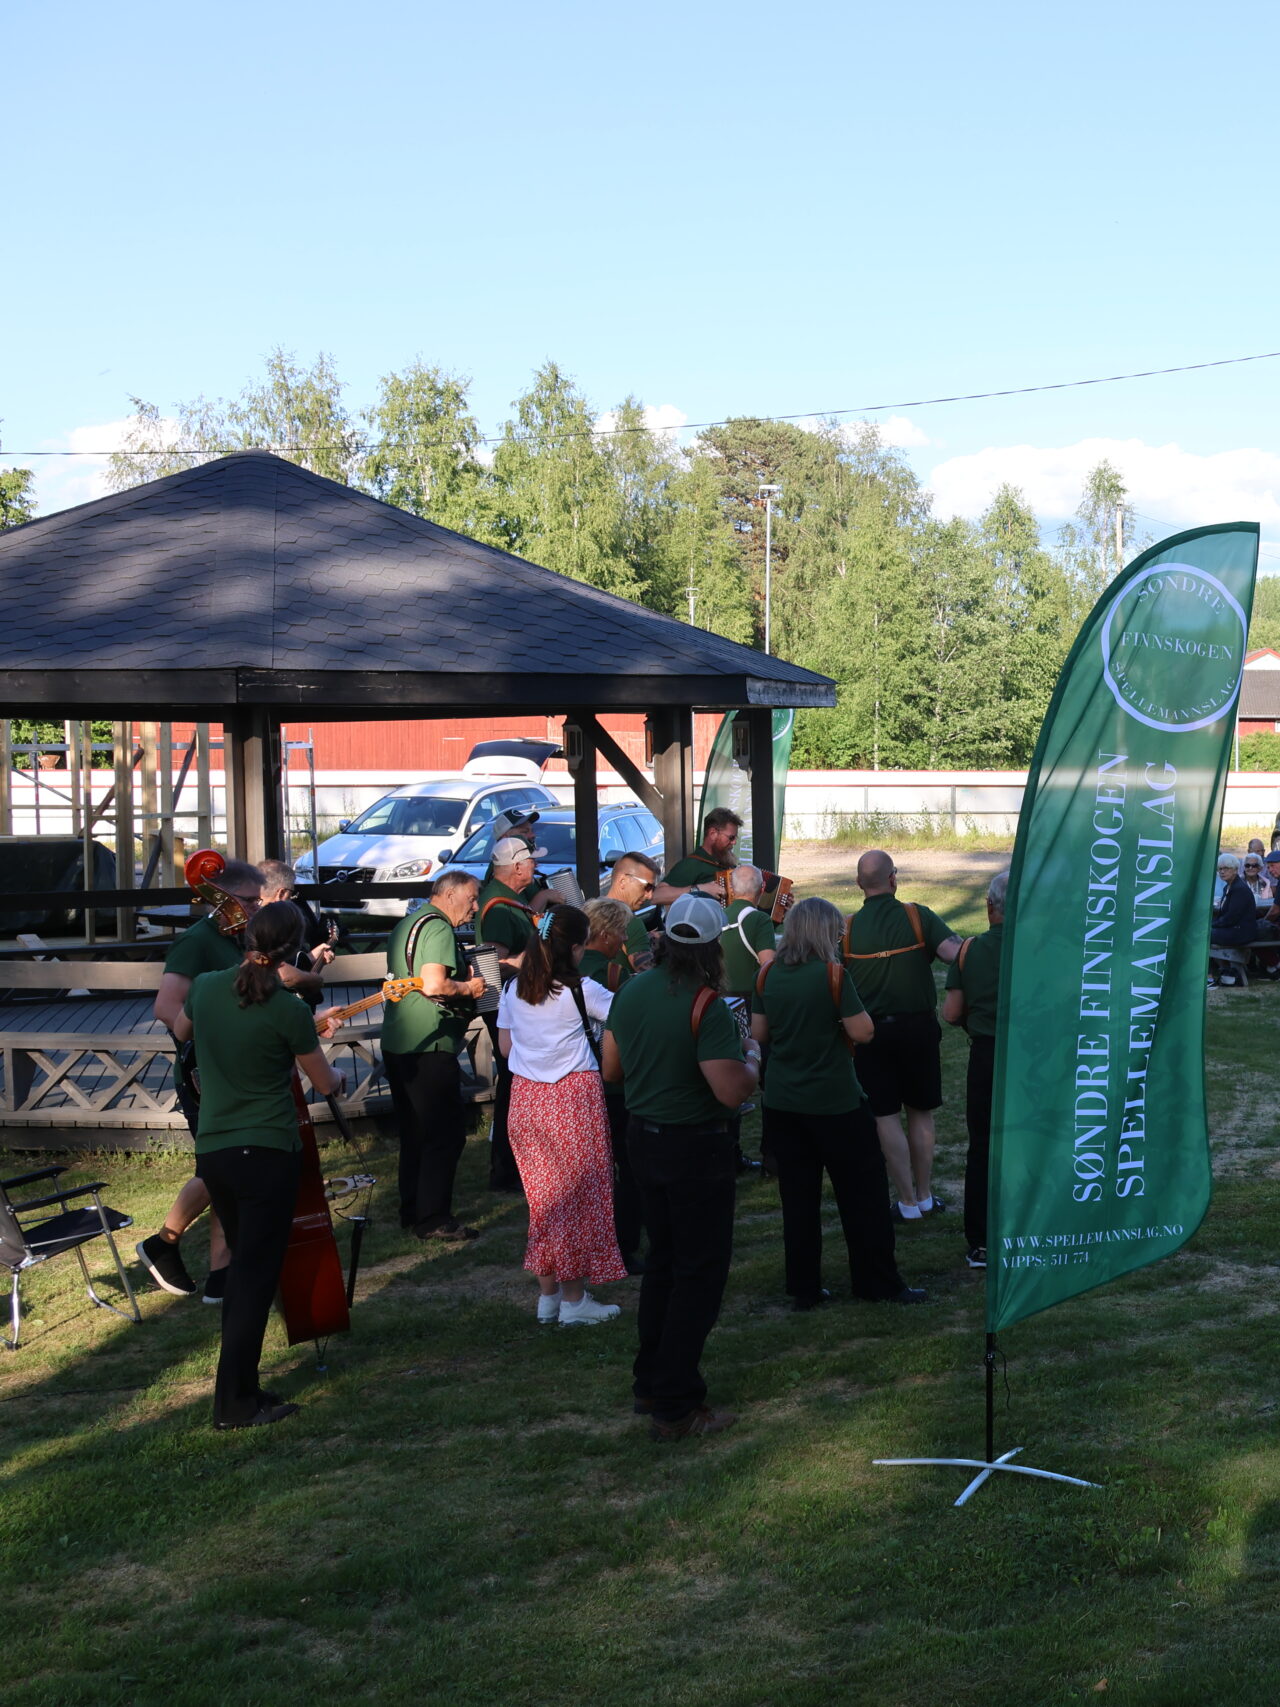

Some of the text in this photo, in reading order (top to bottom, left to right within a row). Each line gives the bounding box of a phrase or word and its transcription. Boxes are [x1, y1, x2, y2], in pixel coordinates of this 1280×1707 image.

[1121, 631, 1234, 660] FINNSKOGEN
[1111, 660, 1236, 720] SPELLEMANNSLAG
[1072, 748, 1129, 1202] SØNDRE FINNSKOGEN
[1115, 759, 1178, 1198] SPELLEMANNSLAG
[1003, 1224, 1184, 1250] WWW.SPELLEMANNSLAG.NO
[1002, 1251, 1089, 1269] VIPPS: 511 774
